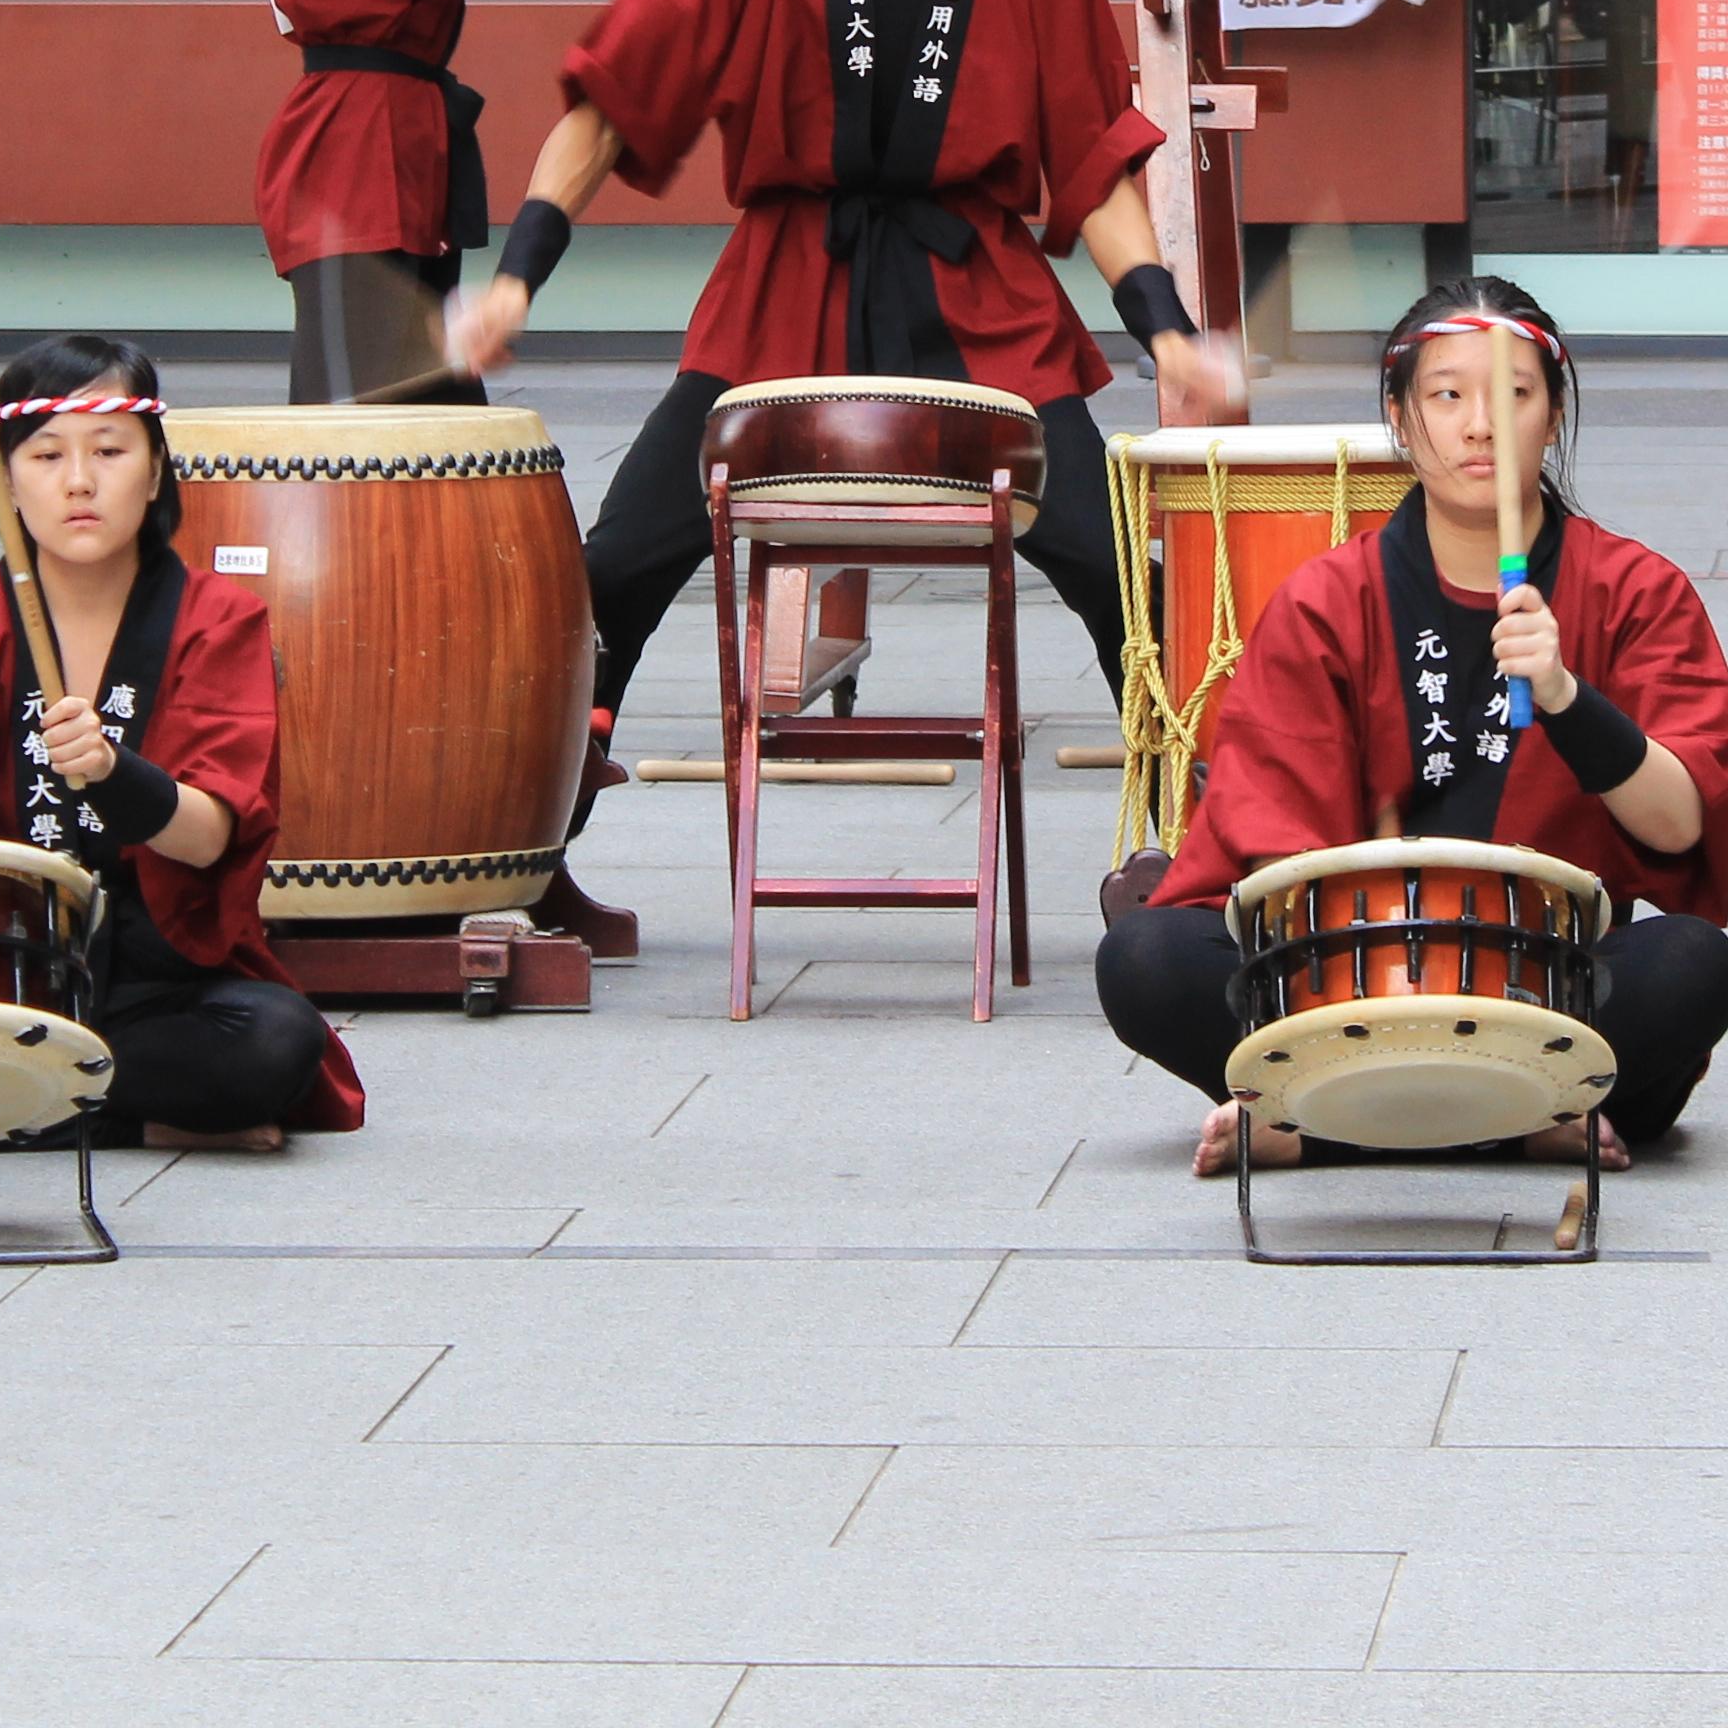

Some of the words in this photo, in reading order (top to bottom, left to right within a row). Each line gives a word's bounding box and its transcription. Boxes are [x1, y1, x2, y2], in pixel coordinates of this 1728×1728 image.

[22, 689, 64, 849] 元智大學
[1414, 628, 1458, 787] 元智大學
